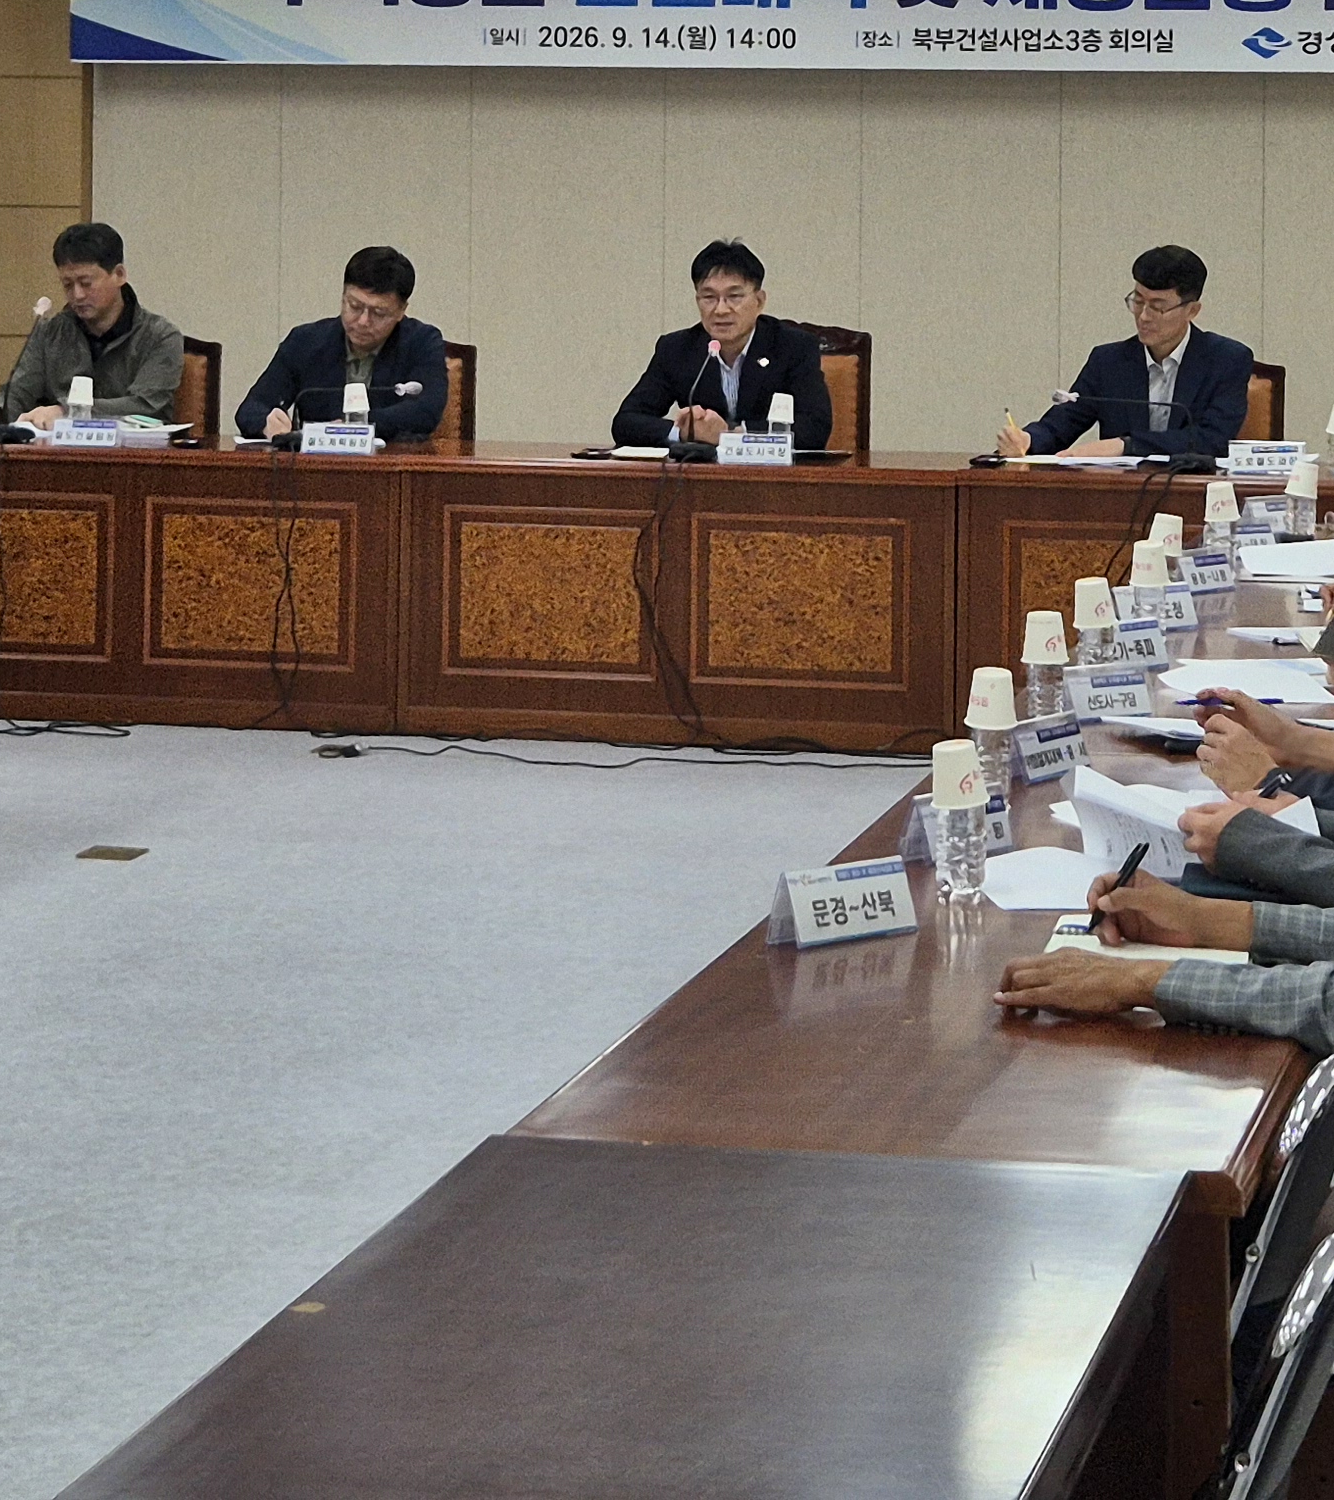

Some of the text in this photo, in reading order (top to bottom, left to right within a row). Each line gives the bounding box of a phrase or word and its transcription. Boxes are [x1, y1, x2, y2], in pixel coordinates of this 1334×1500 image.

[538, 26, 605, 48] 2026.
[612, 26, 633, 48] 9.
[642, 24, 717, 51] 14.(월)
[726, 27, 796, 49] 14:00
[911, 28, 1103, 53] 북부건설사업소3층
[1108, 28, 1174, 53] 회의실
[811, 890, 896, 928] 문경~산북
